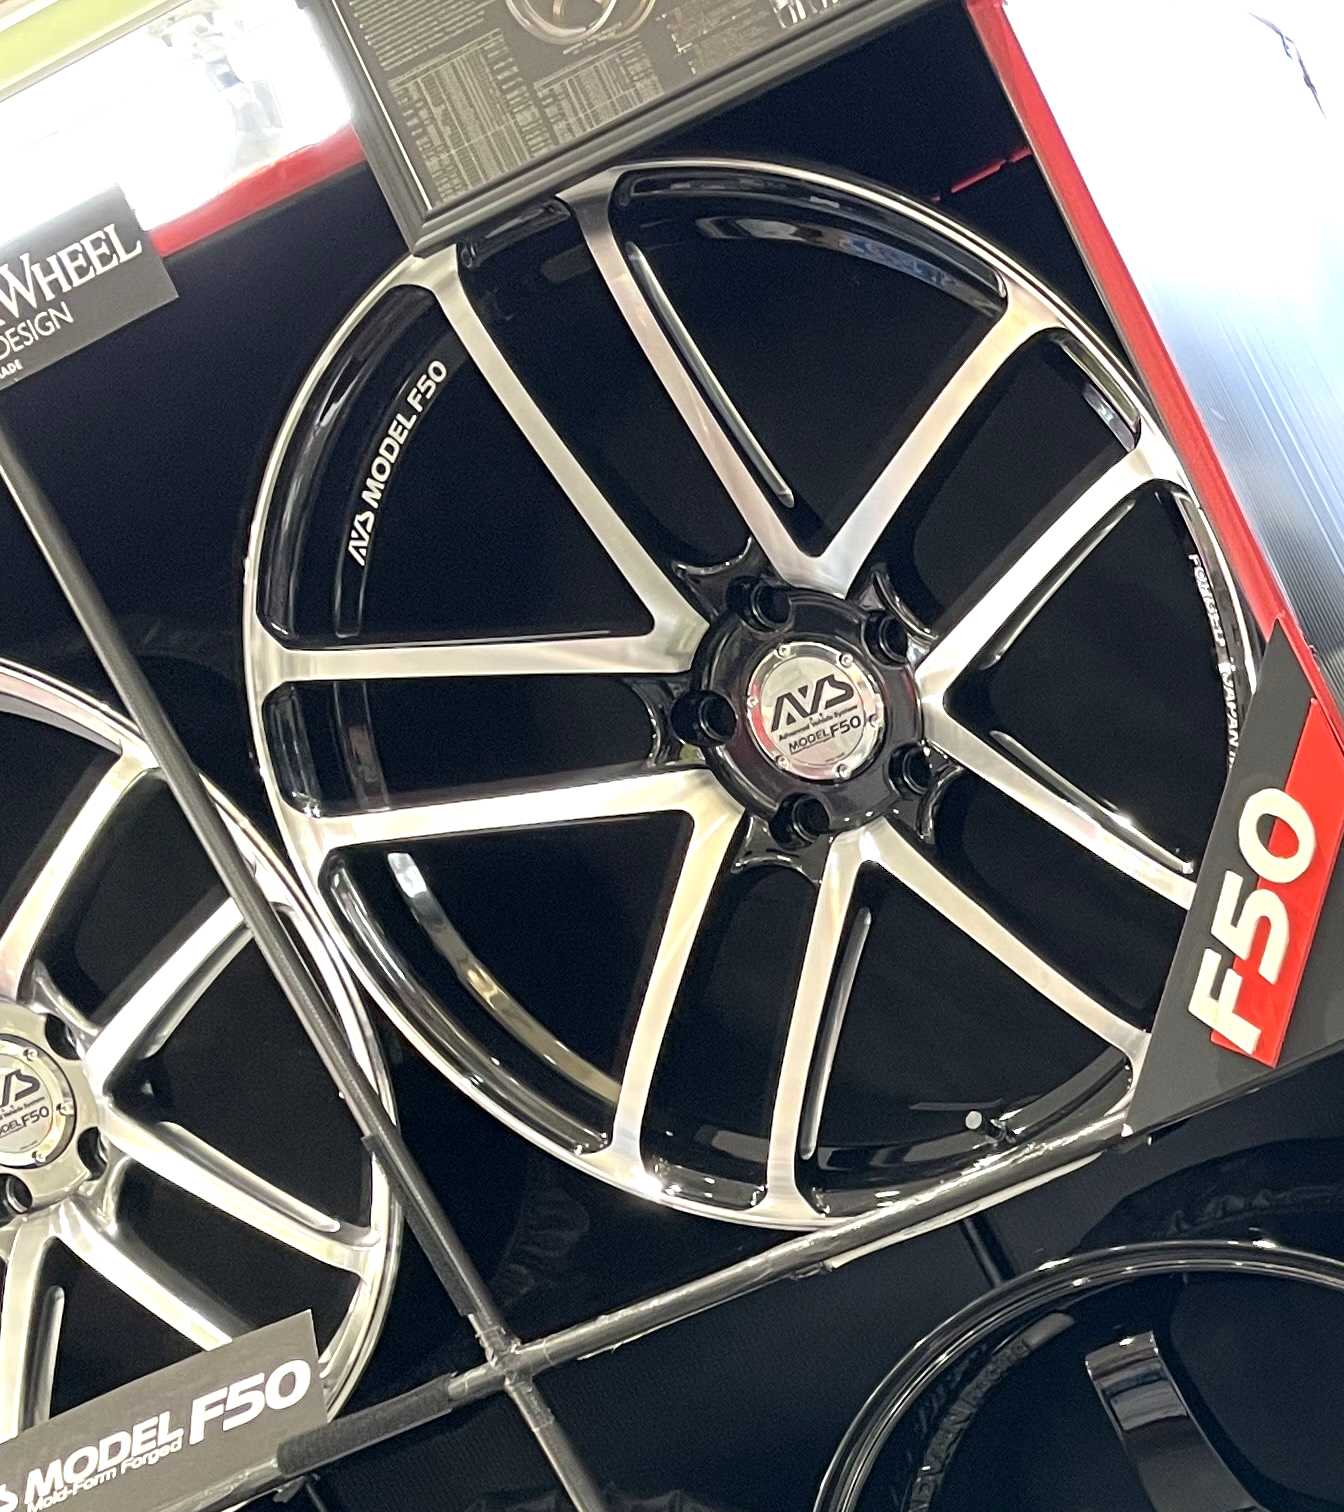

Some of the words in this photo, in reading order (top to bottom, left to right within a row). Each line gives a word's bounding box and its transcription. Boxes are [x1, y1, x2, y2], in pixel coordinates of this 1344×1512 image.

[361, 413, 417, 508] MODEL
[407, 360, 447, 412] F50
[788, 731, 831, 753] MODEL
[829, 714, 862, 739] F50
[1188, 787, 1316, 1055] F50
[24, 1412, 184, 1494] MODEL
[189, 1359, 312, 1445] F50
[120, 1435, 183, 1479] Forged
